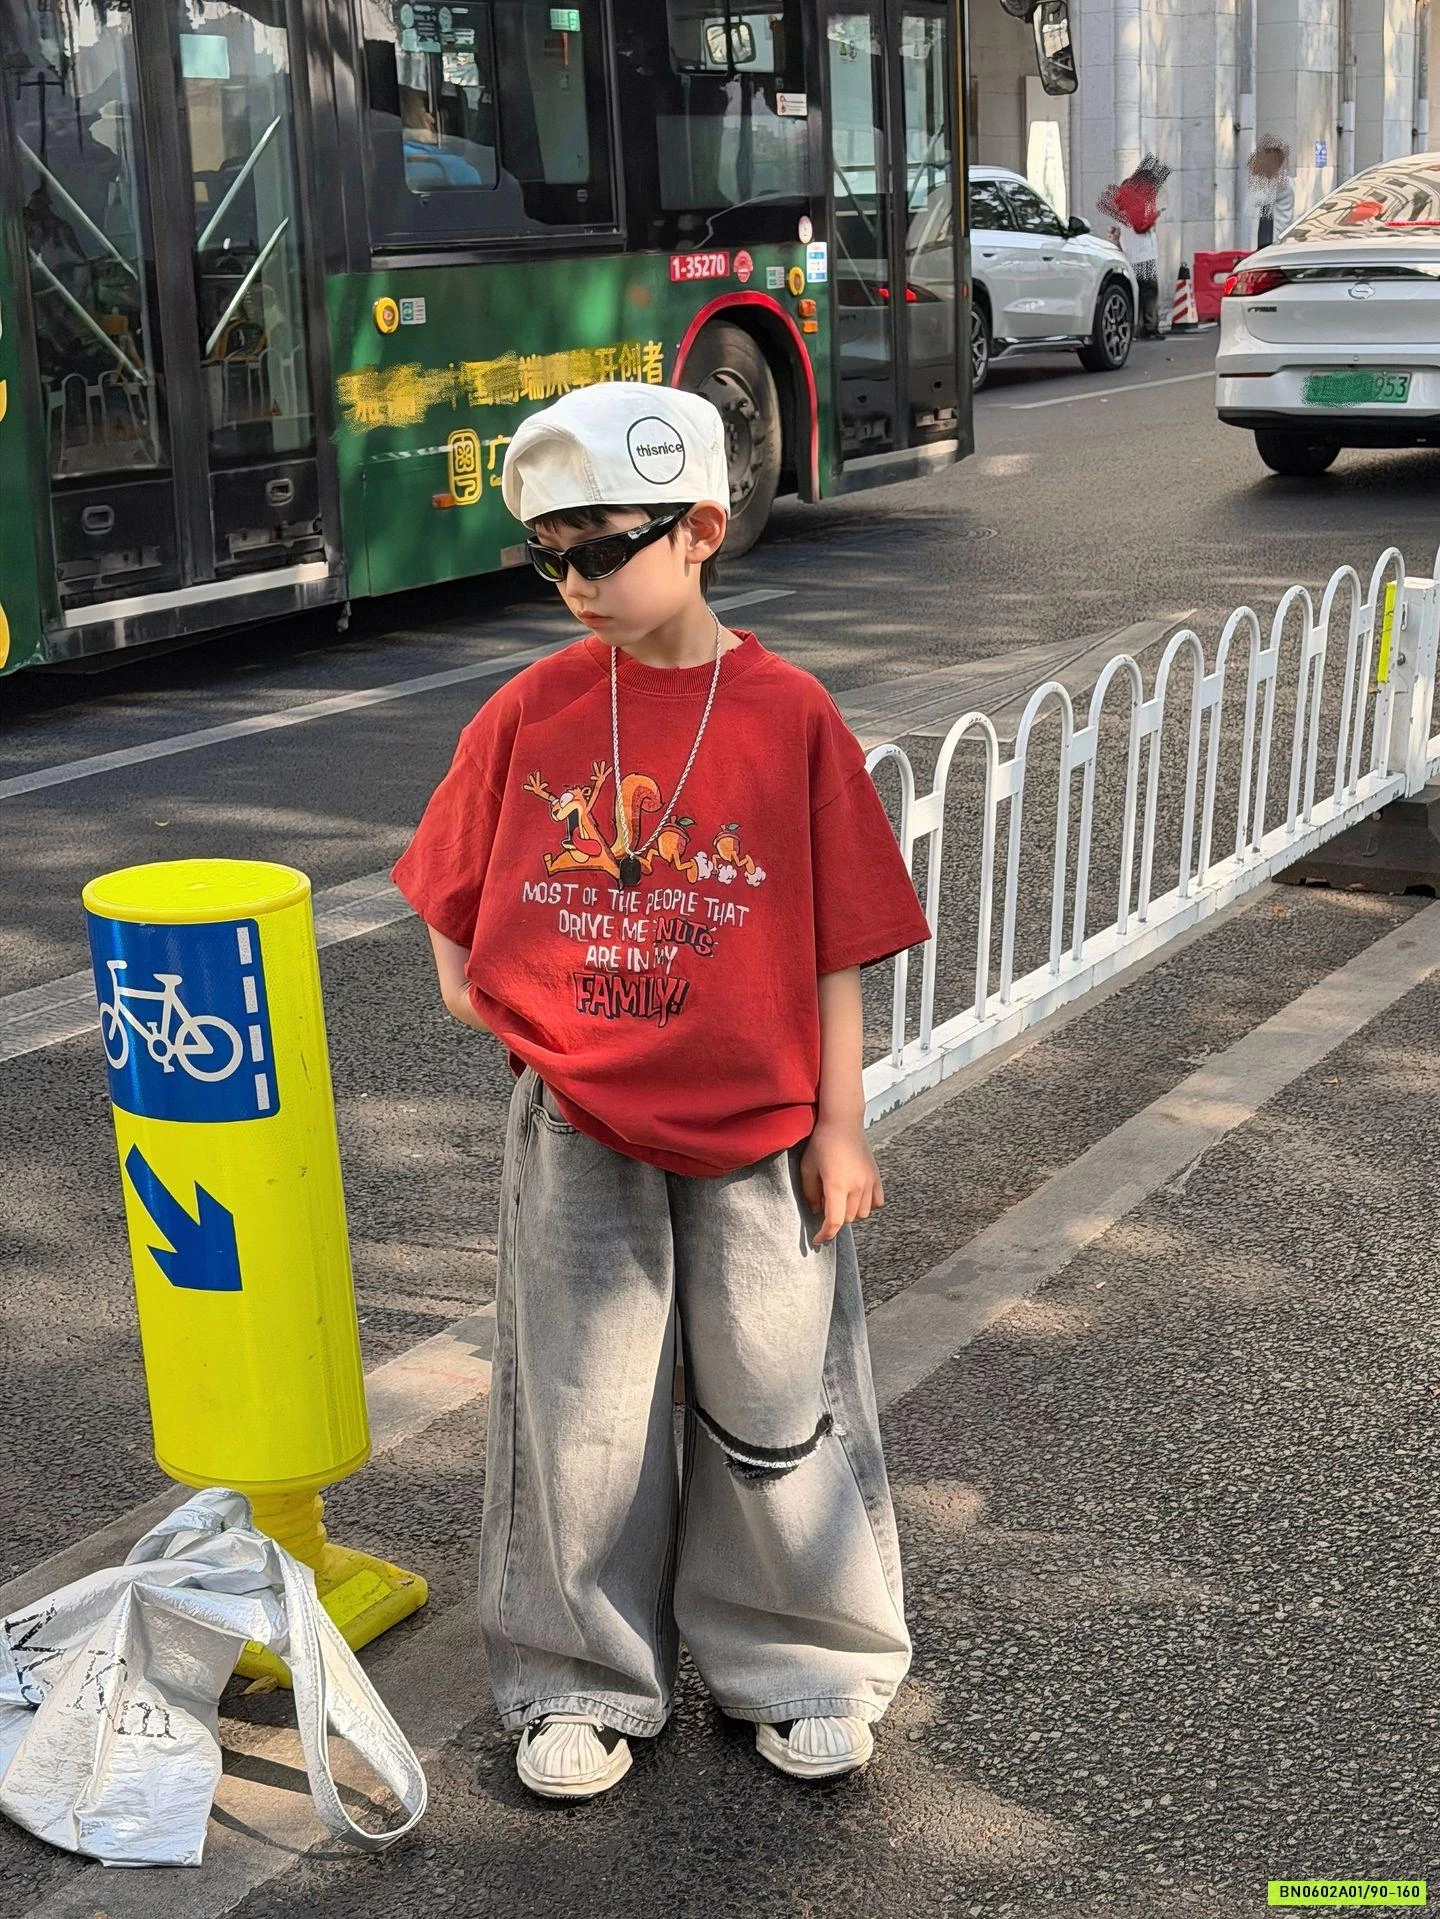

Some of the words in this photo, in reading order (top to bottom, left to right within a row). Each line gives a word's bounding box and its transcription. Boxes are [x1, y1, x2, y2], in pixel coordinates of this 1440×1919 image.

[672, 254, 726, 281] 1-35270
[635, 441, 684, 458] thisnice
[522, 881, 578, 904] MOST
[583, 888, 600, 906] OF
[608, 889, 642, 915] THE
[646, 888, 698, 916] PEOPLE
[703, 897, 750, 928] THAT
[559, 909, 614, 942] DRIVE
[621, 918, 649, 943] ME
[656, 917, 714, 957] NUTS
[585, 945, 621, 974] ARE
[626, 945, 649, 972] IN
[653, 945, 678, 975] MY
[573, 972, 691, 1029] FAMILY!
